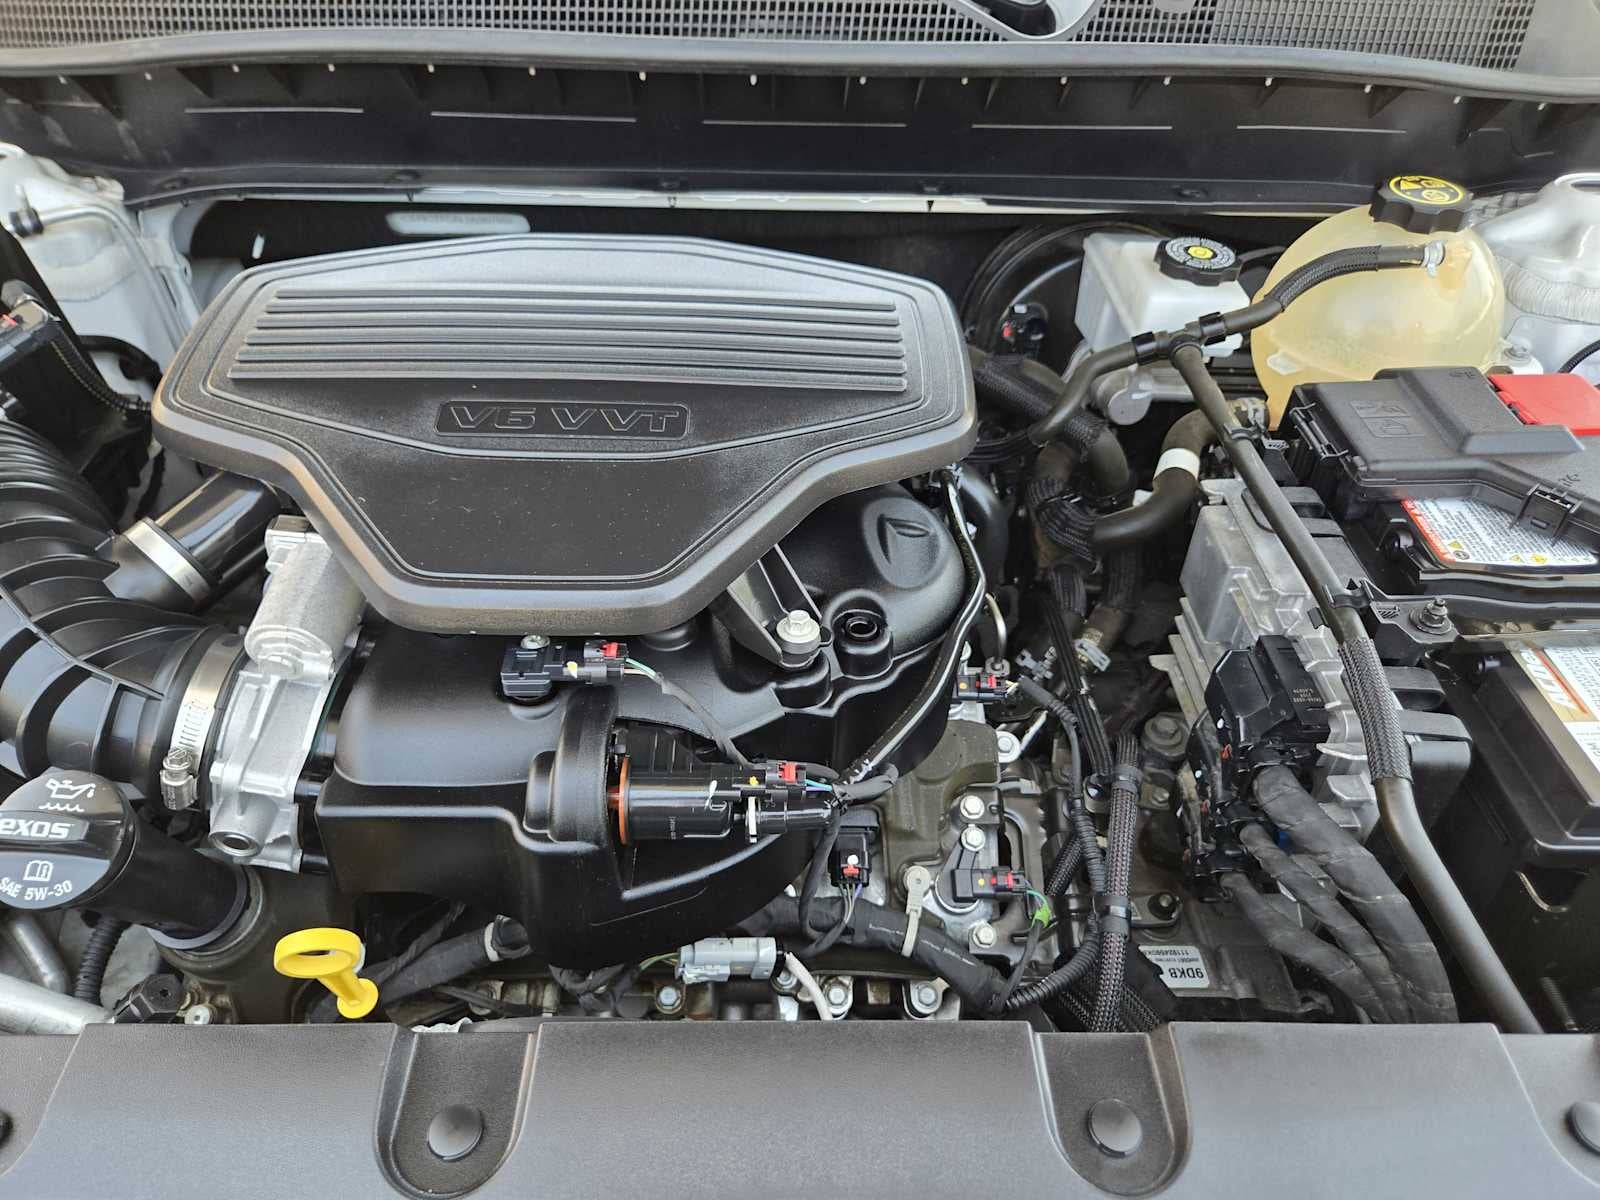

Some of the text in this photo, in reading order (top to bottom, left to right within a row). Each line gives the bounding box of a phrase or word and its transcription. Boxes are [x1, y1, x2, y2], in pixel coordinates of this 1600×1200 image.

[450, 406, 680, 432] V6 VVT
[0, 818, 72, 839] exos
[0, 877, 73, 901] SAE 5W-30
[1168, 967, 1204, 979] 9DKB
